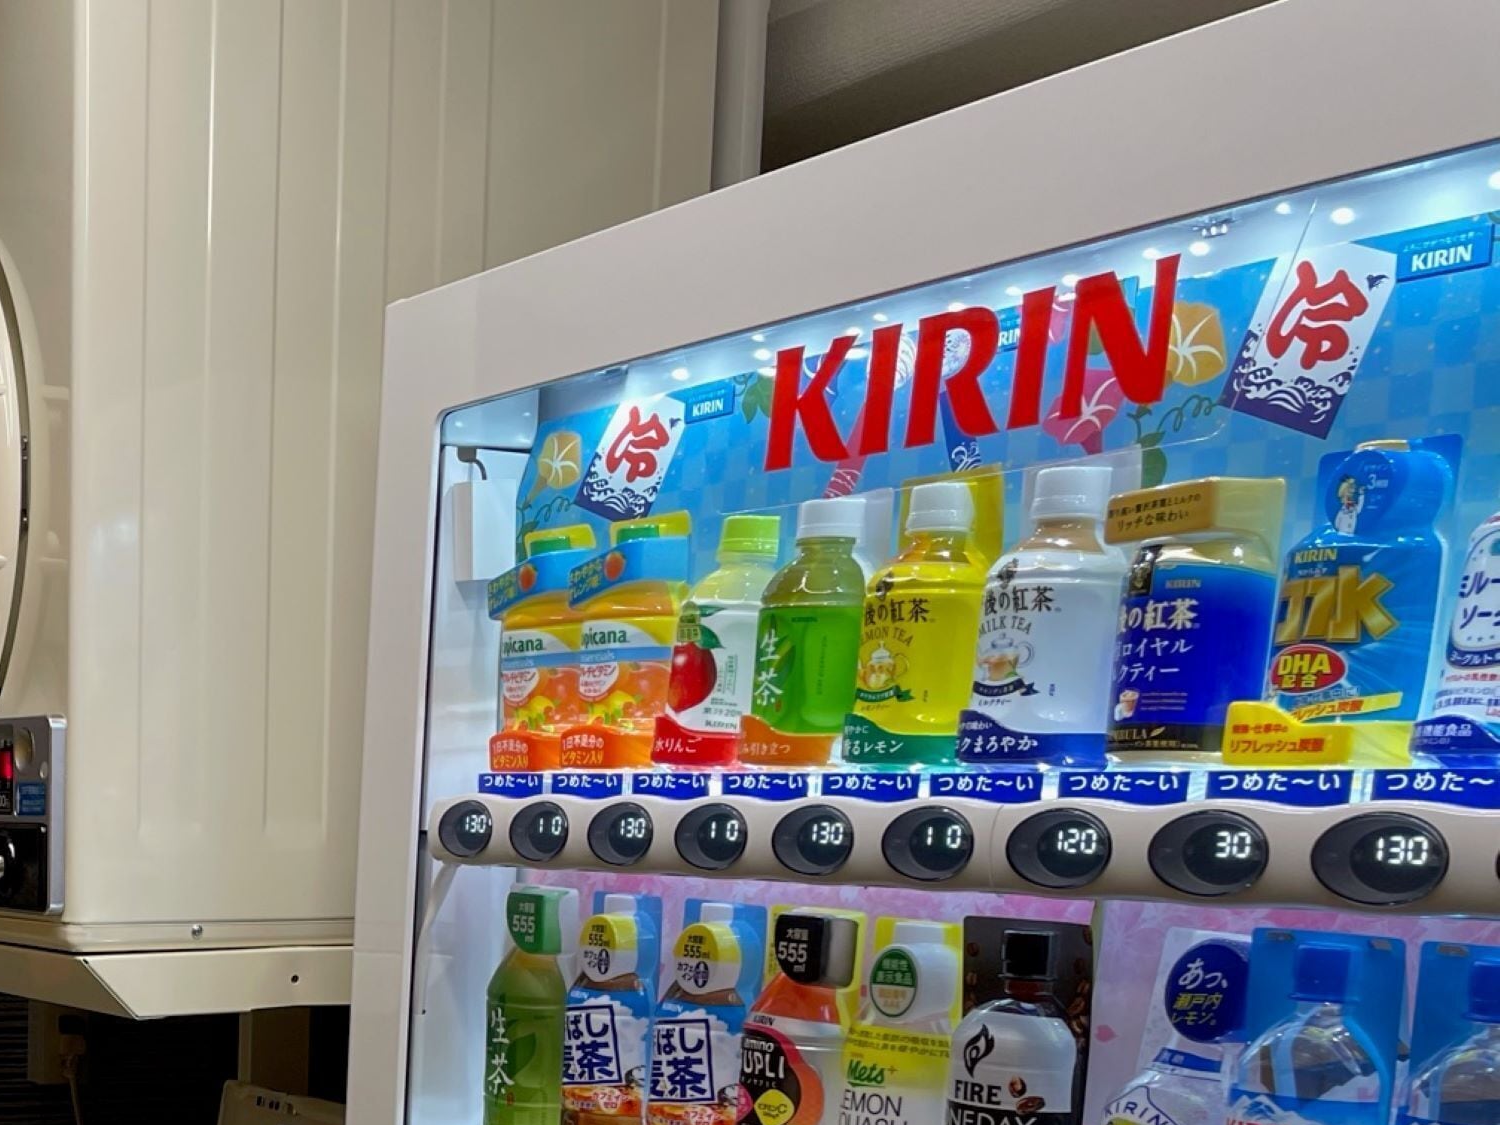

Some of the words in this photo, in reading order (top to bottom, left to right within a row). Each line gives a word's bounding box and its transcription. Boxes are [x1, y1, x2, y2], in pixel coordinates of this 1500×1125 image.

[1411, 243, 1473, 272] KIRIN
[765, 253, 1180, 472] KIRIN
[692, 398, 724, 418] KIRIN
[1294, 549, 1338, 564] KIRIN
[864, 599, 930, 625] 後の紅茶
[984, 587, 1055, 616] 後の紅茶
[892, 626, 914, 648] TEA
[1011, 616, 1033, 636] TEA
[754, 629, 784, 709] 生茶
[1278, 653, 1331, 675] DHA
[1282, 674, 1318, 688] 配合
[619, 818, 646, 838] 130
[811, 822, 845, 845] 130
[1057, 829, 1098, 855] 120
[1376, 837, 1428, 866] 130
[512, 916, 536, 933] 555
[786, 928, 809, 940] 大容量
[778, 941, 808, 963] 555
[487, 1007, 515, 1096] 生茶
[954, 1079, 1002, 1106] FIRE
